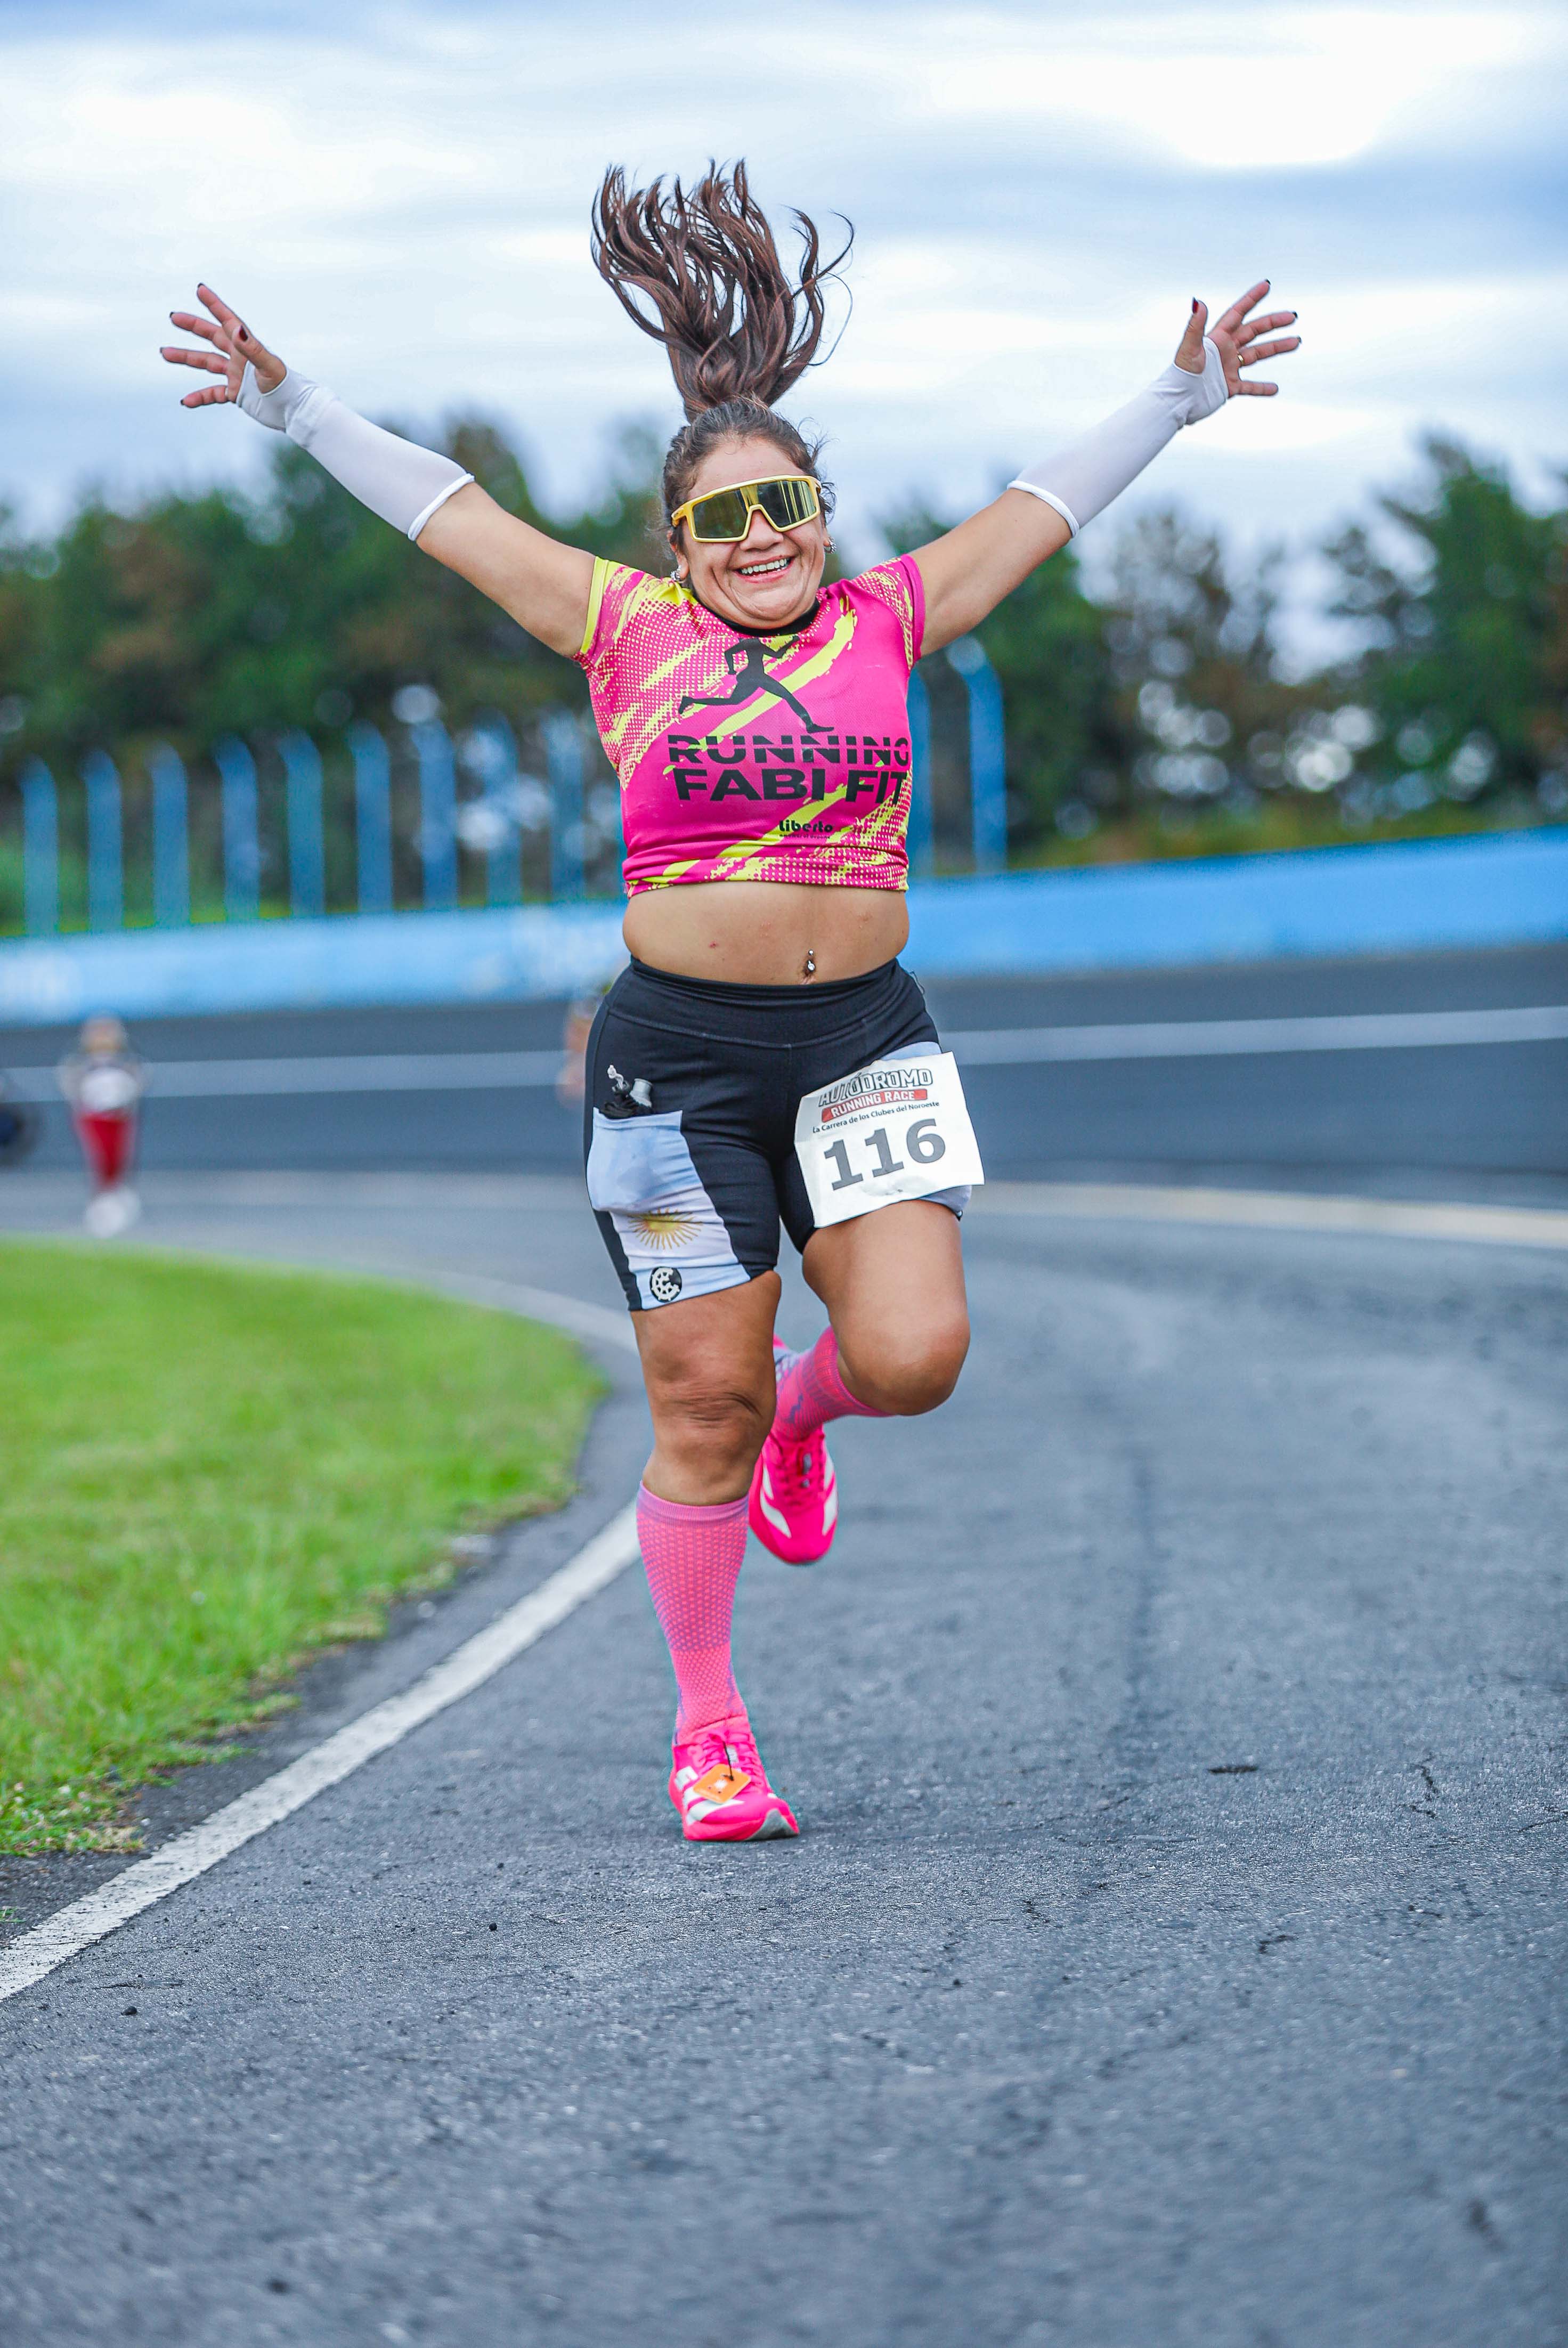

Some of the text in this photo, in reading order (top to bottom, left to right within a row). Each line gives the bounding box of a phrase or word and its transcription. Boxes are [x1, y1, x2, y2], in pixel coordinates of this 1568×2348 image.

[668, 735, 908, 766] RUNNING
[672, 768, 907, 804] FABI FIT
[821, 1120, 847, 1131] Carrera
[871, 1109, 895, 1117] Clubes
[908, 1101, 939, 1110] Noroeste
[831, 1090, 915, 1118] RUNNING RACE
[824, 1118, 946, 1191] 116
